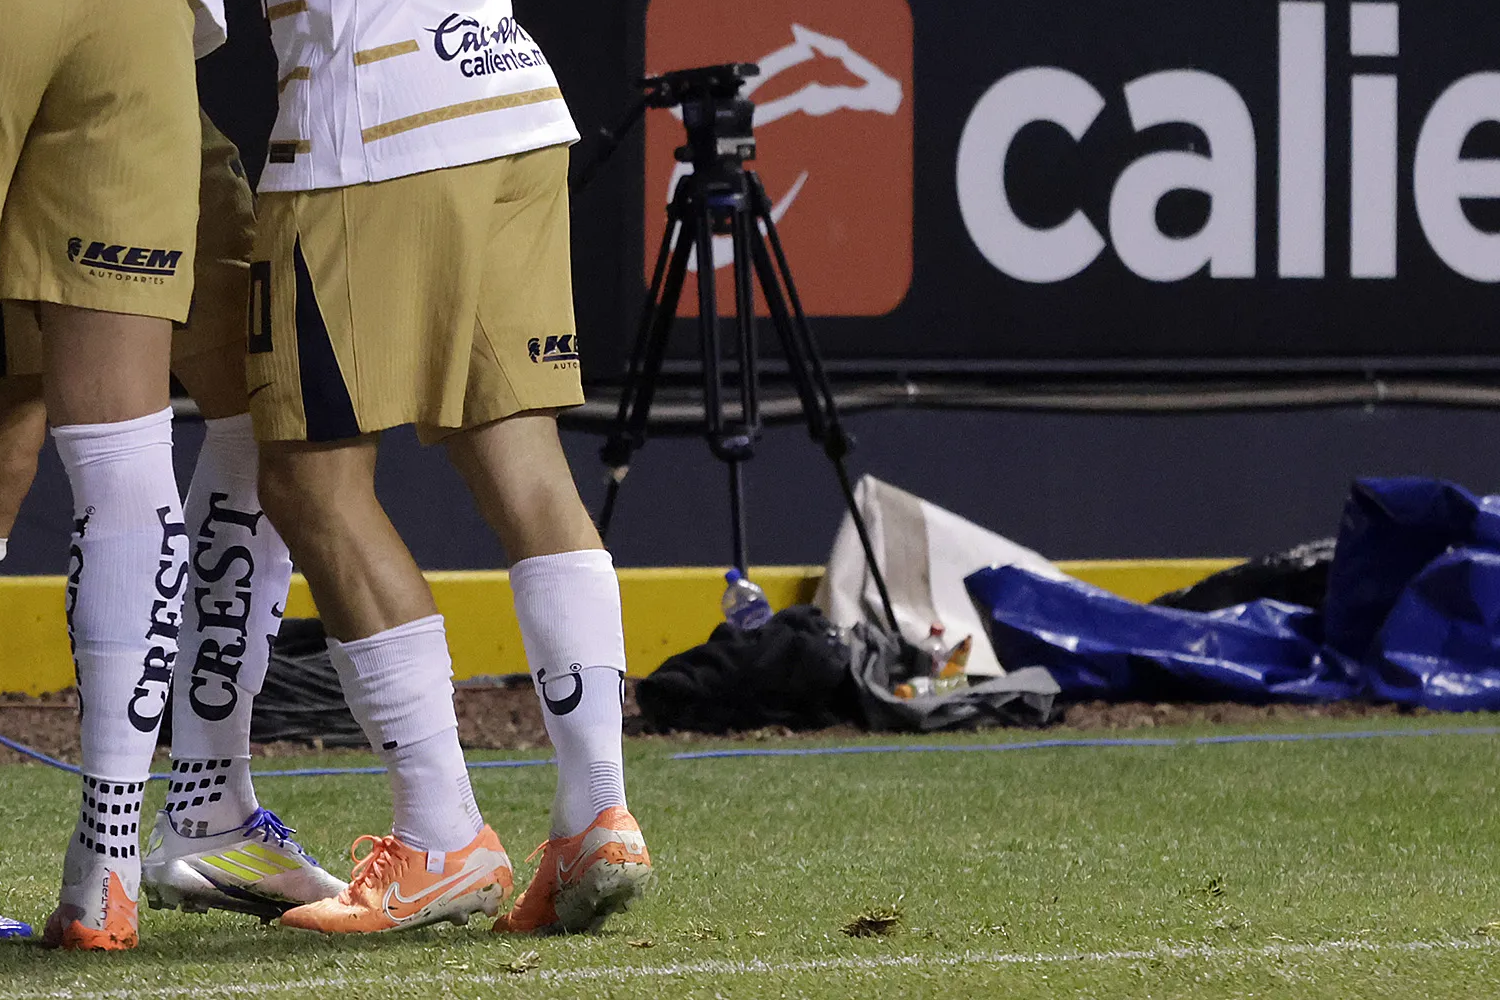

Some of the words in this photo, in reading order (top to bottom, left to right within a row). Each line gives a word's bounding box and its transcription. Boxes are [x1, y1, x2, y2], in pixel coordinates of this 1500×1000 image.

[83, 241, 183, 269] KEM
[127, 506, 190, 733] CREST
[189, 492, 263, 722] CREST
